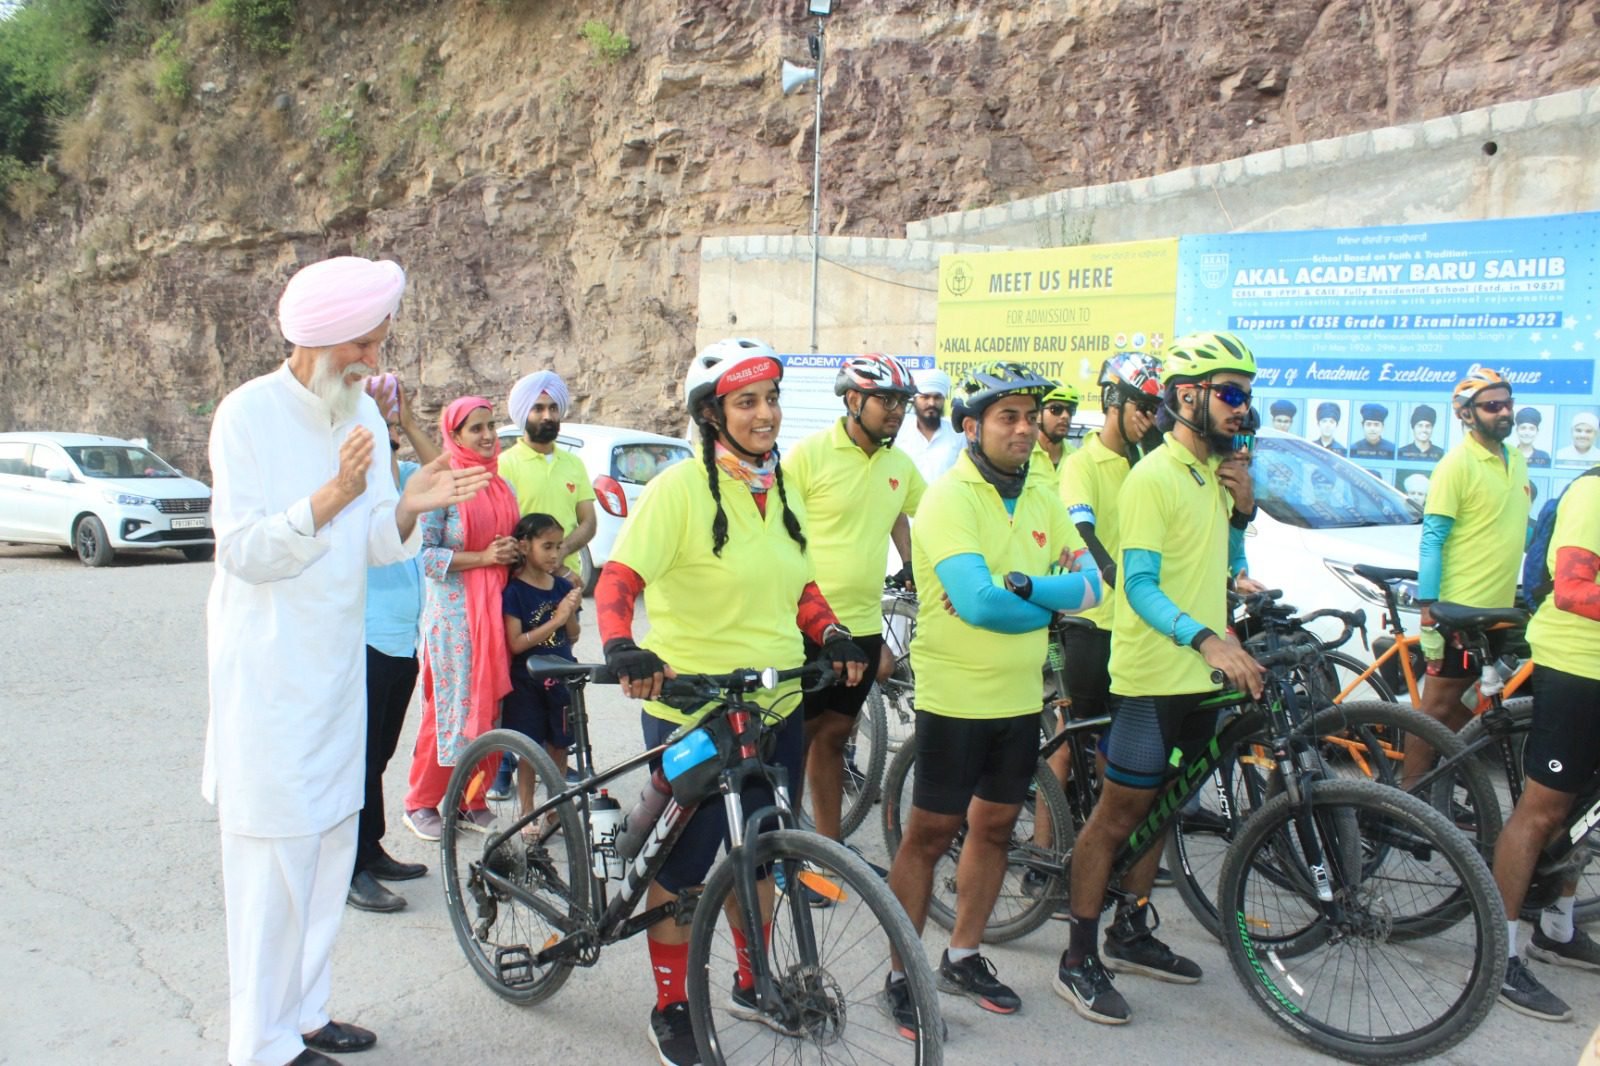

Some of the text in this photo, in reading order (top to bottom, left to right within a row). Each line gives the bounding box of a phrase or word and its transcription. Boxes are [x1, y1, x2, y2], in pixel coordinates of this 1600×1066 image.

[1312, 254, 1341, 263] School
[1344, 253, 1371, 262] Based
[1374, 253, 1386, 261] on
[1388, 252, 1411, 260] Faith
[1425, 250, 1468, 259] Tradition
[989, 267, 1113, 293] MEET US HERE
[1234, 257, 1565, 286] AKAL ACADEMY BARU SAHIB
[1344, 287, 1367, 297] Fully
[1372, 286, 1429, 295] Residential
[1434, 285, 1469, 293] School
[1510, 282, 1520, 291] in
[1344, 298, 1396, 306] education
[1402, 296, 1425, 304] with
[1430, 295, 1480, 305] spiritual
[1485, 293, 1563, 304] rejuvenation
[1007, 307, 1090, 325] FOR ADMISSION TO
[1236, 313, 1556, 330] Toppers of CBSE Grade 12 Examination-2022
[944, 334, 1109, 352] AKAL ACADEMY BARU SAHIB
[786, 356, 841, 368] ACADEMY
[901, 357, 920, 369] HIB
[1306, 361, 1370, 382] Academic
[1378, 361, 1457, 383] Excellence
[1128, 735, 1221, 853] GHOST
[618, 796, 682, 902] TRE
